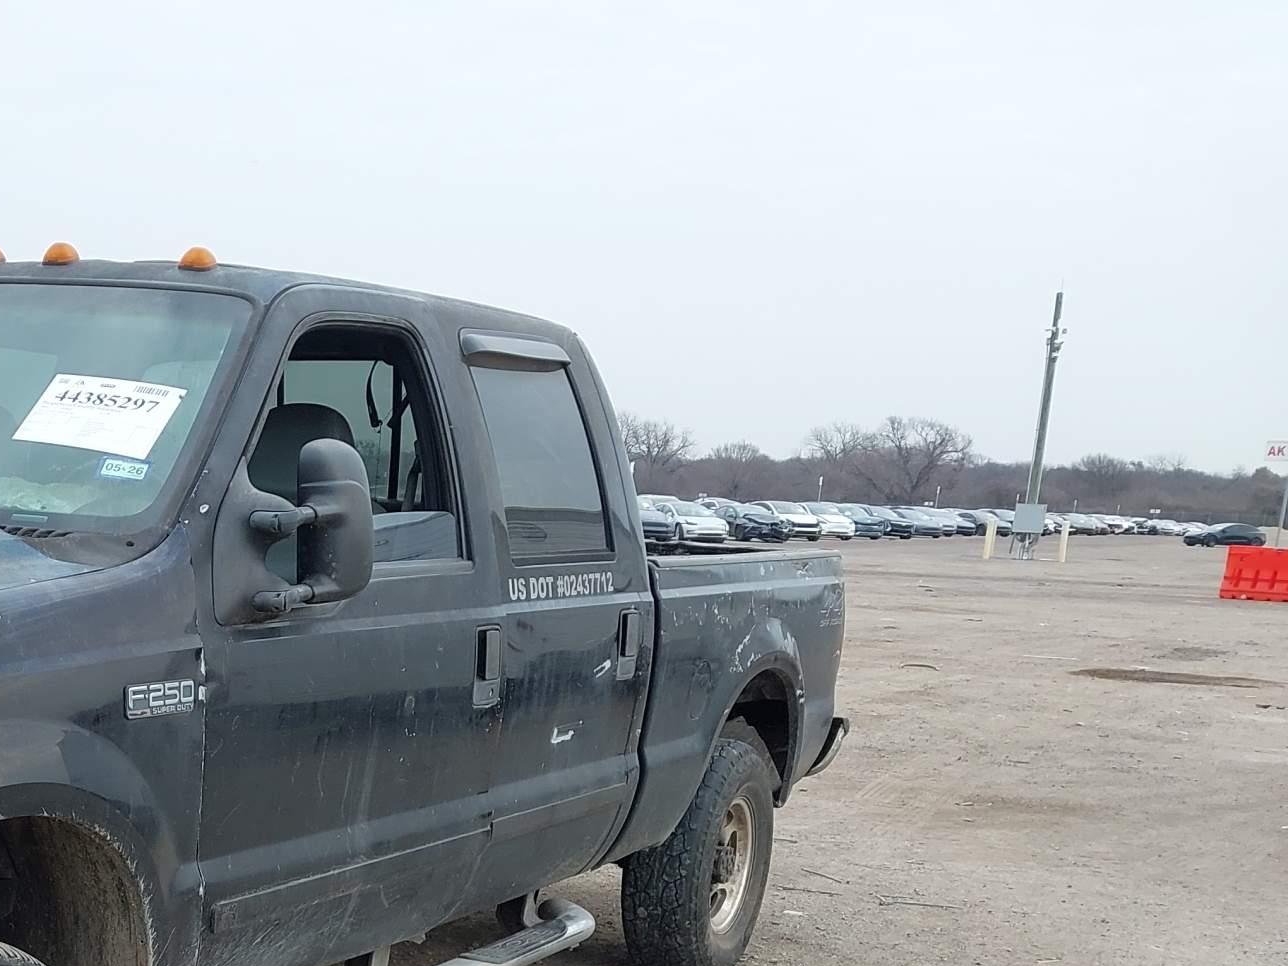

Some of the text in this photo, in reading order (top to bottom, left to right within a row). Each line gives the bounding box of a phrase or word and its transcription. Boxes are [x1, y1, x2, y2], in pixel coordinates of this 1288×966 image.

[55, 389, 161, 413] 44385297
[1267, 445, 1287, 457] AK
[508, 571, 614, 601] US DOT #02437712
[152, 705, 176, 714] SUPER
[177, 703, 194, 712] DUTY
